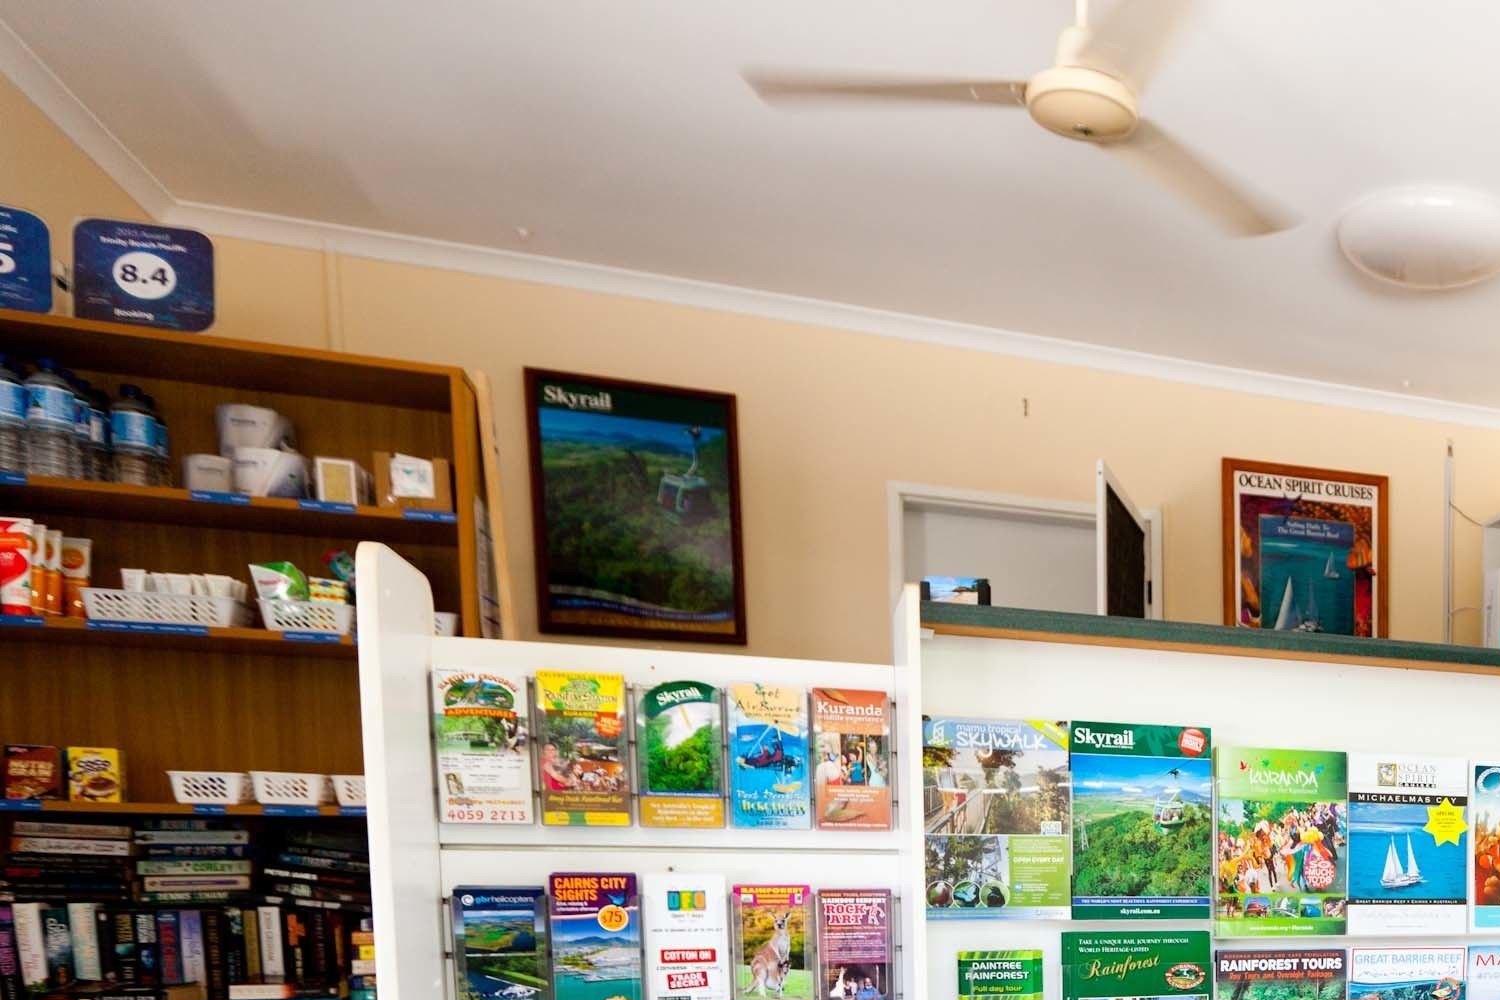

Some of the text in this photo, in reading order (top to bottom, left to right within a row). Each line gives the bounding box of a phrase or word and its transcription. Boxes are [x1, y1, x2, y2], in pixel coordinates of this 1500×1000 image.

[120, 263, 169, 286] 8.4
[113, 308, 154, 321] Booking
[543, 384, 612, 411] Skyrail
[1239, 474, 1373, 500] OCEAN SPIRIT CRUISES
[656, 687, 702, 706] Skyrail
[817, 701, 883, 716] Kuranda
[956, 723, 1022, 735] mamu tropical
[1074, 727, 1134, 750] Skyrail
[1398, 773, 1437, 783] SPIRIT
[1358, 793, 1431, 803] MICHAELMAS
[448, 810, 526, 821] 4059 2713
[1309, 860, 1330, 870] SO
[1307, 869, 1333, 877] MUCH
[554, 878, 627, 889] CAIRNS CITY
[1308, 876, 1318, 884] TO
[554, 890, 598, 901] SIGHTS
[824, 904, 866, 914] ROCK
[829, 914, 863, 925] ART
[664, 951, 712, 961] COTTON ON
[1355, 953, 1462, 964] GREAT BARRIER REEF
[972, 961, 1022, 971] DAINTREE
[1080, 955, 1160, 981] Rainforest
[1220, 958, 1342, 972] RAINFOREST TOURS
[670, 973, 703, 982] TRADE
[965, 971, 1029, 981] RAINFOREST
[670, 979, 706, 989] SECRET
